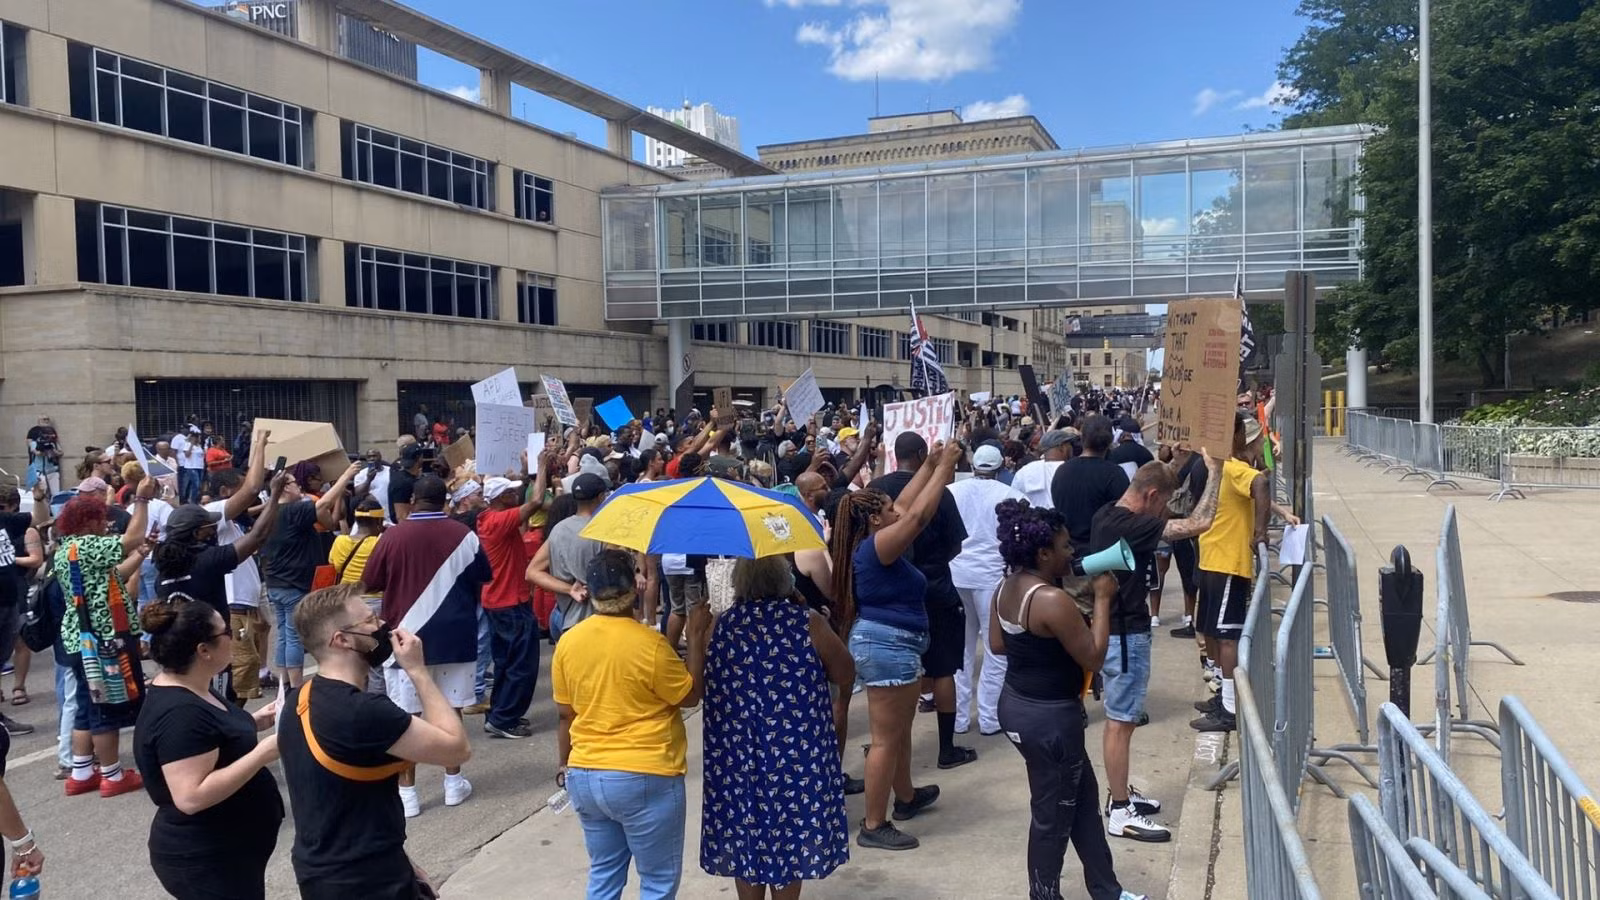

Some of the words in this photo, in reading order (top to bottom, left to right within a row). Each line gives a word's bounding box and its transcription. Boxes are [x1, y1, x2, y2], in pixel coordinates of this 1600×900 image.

[251, 4, 286, 20] PNC
[1171, 332, 1188, 350] THAT
[1177, 406, 1182, 422] A
